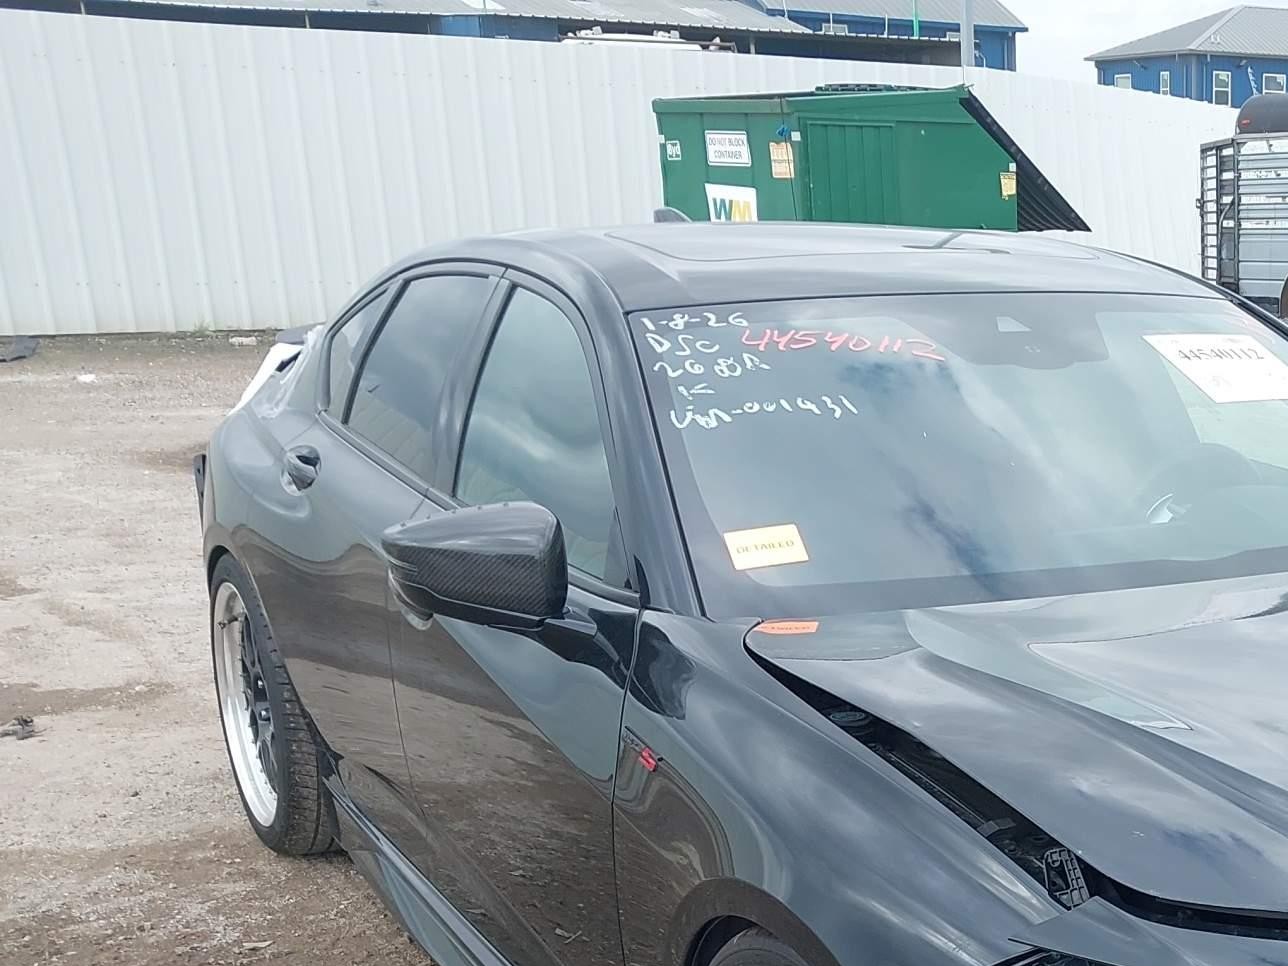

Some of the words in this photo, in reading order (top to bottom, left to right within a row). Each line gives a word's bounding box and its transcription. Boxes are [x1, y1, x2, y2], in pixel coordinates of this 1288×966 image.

[728, 137, 745, 147] BLOCK
[713, 150, 743, 160] CONTAINER
[712, 198, 753, 222] WM
[741, 328, 945, 362] 44540112
